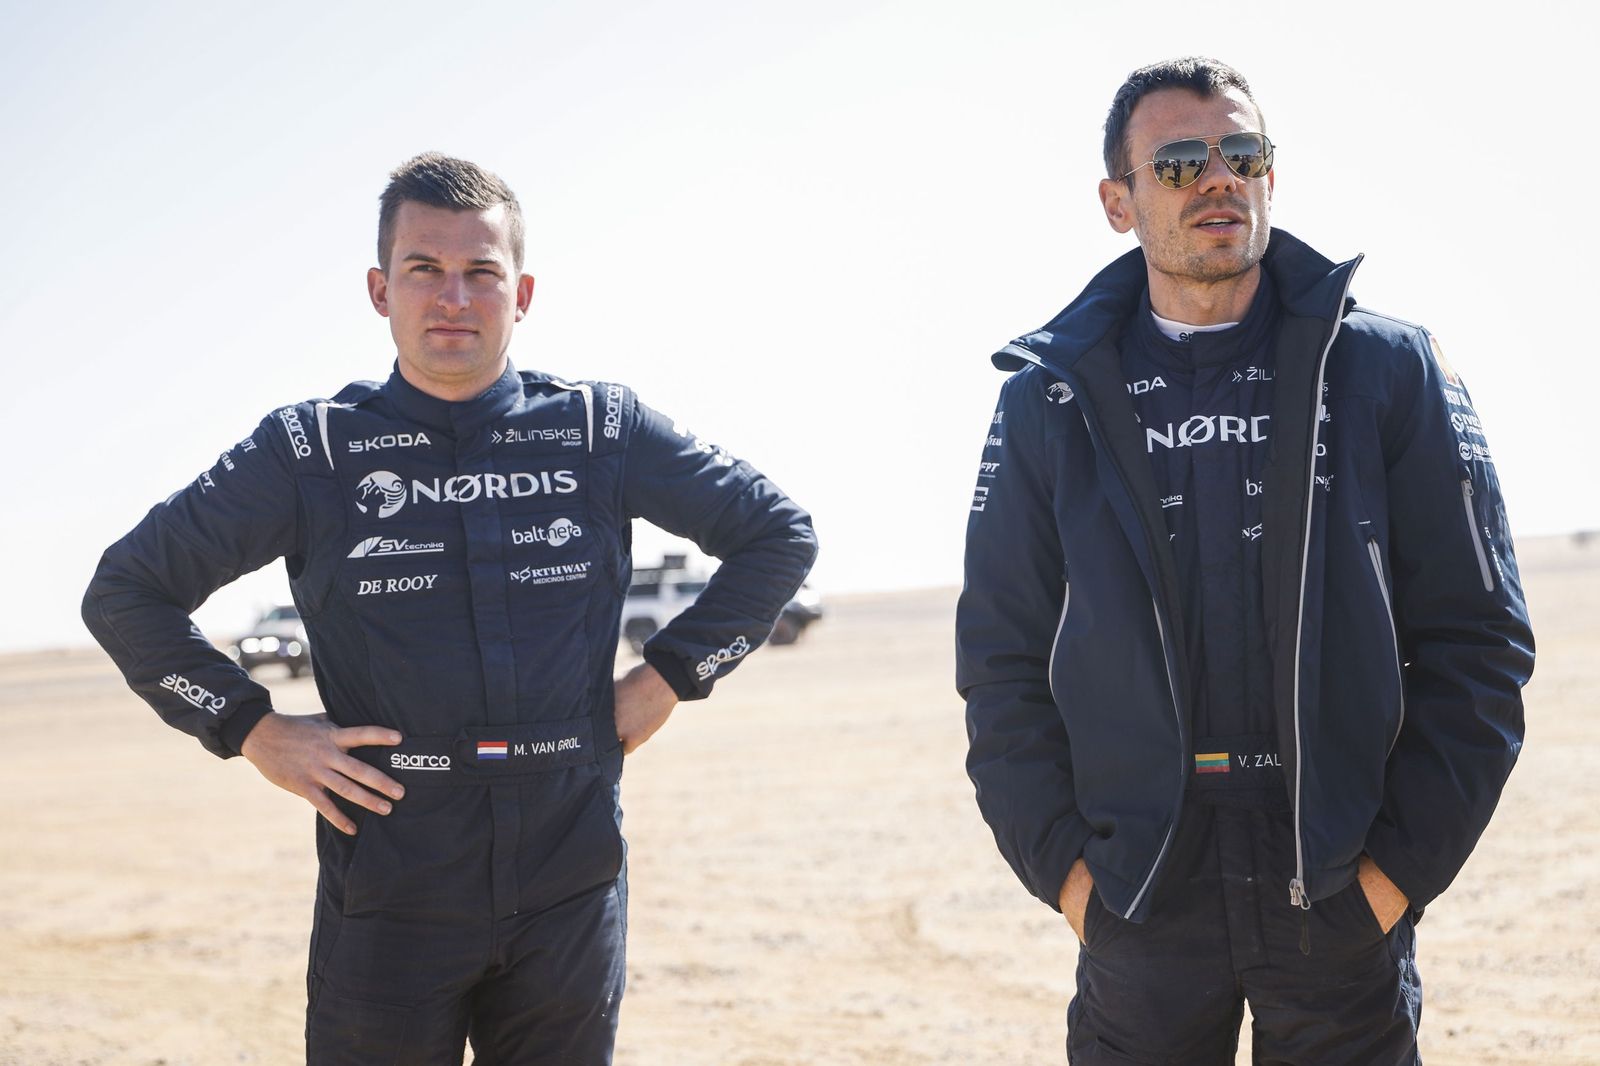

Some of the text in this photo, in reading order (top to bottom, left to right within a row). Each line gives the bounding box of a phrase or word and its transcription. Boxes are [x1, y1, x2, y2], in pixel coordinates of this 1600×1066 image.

[603, 384, 624, 440] sparco
[357, 574, 438, 595] DE ROOY
[514, 736, 581, 756] M. VAN GROL
[390, 752, 451, 770] sparco
[1237, 754, 1250, 768] V.
